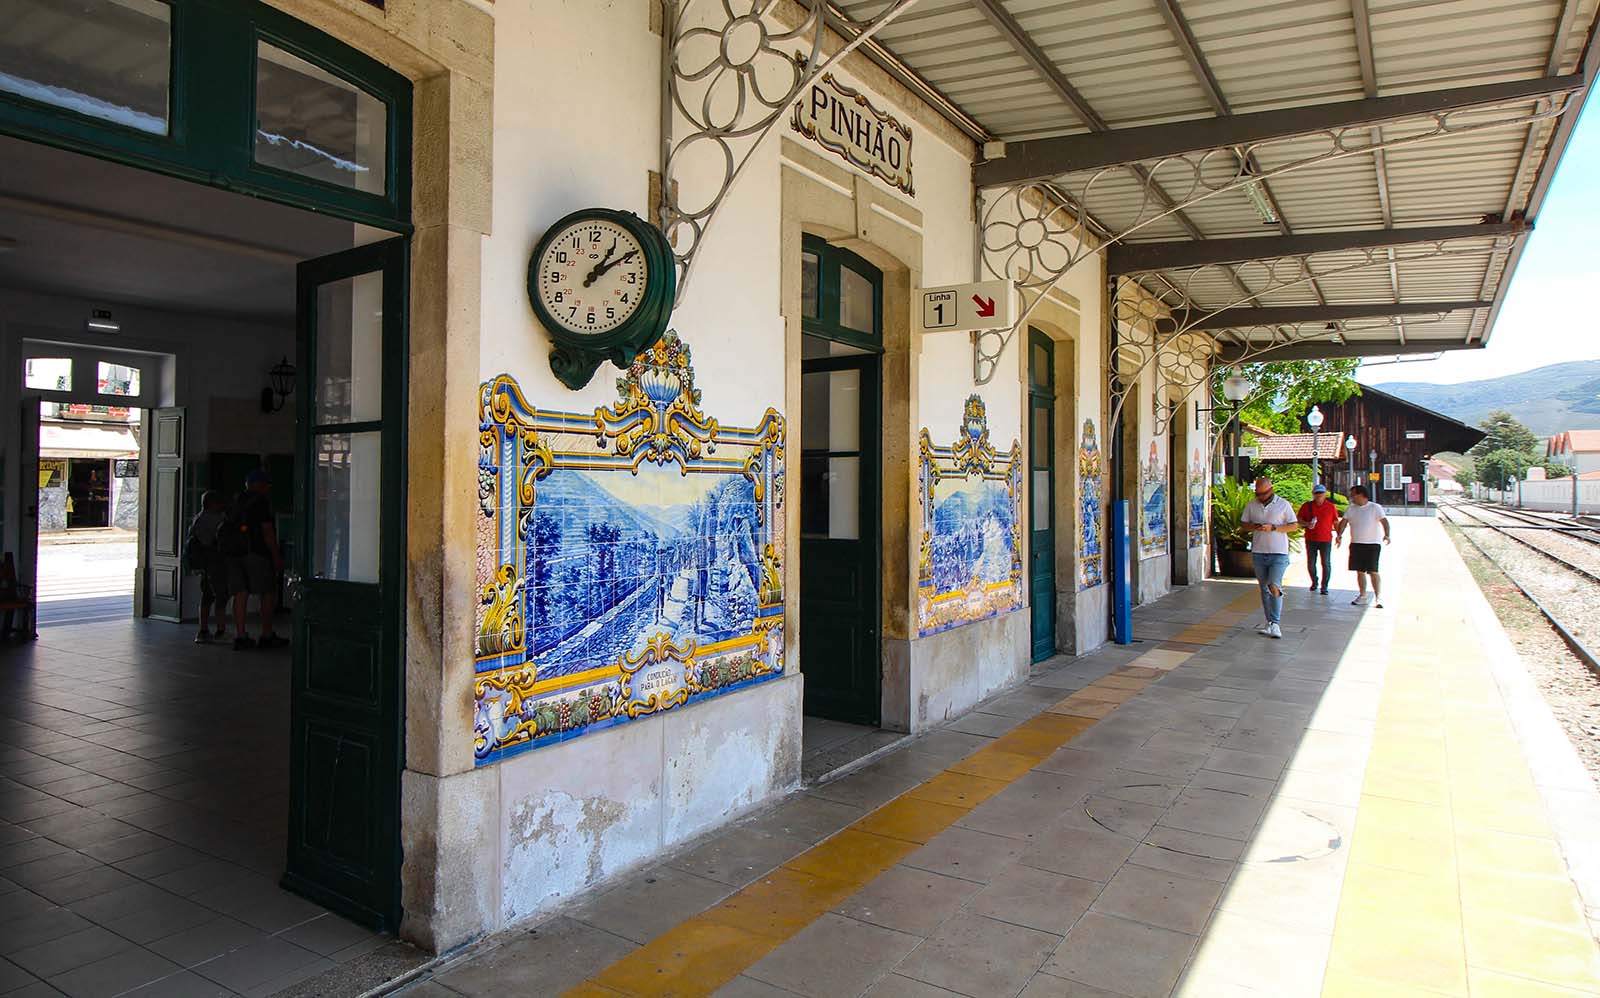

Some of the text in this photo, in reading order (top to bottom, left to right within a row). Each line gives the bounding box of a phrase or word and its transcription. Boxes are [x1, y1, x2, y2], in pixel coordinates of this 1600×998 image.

[810, 84, 901, 170] PINHÃO
[589, 231, 601, 242] 12
[573, 237, 580, 248] 11
[556, 252, 567, 263] 10
[551, 272, 560, 283] 9
[627, 272, 636, 284] 3
[555, 292, 563, 303] 8
[620, 293, 628, 304] 4
[929, 293, 951, 302] Linha
[569, 307, 577, 317] 7
[606, 308, 614, 318] 5
[933, 304, 943, 324] 1
[587, 313, 595, 324] 6
[640, 681, 654, 691] PARA
